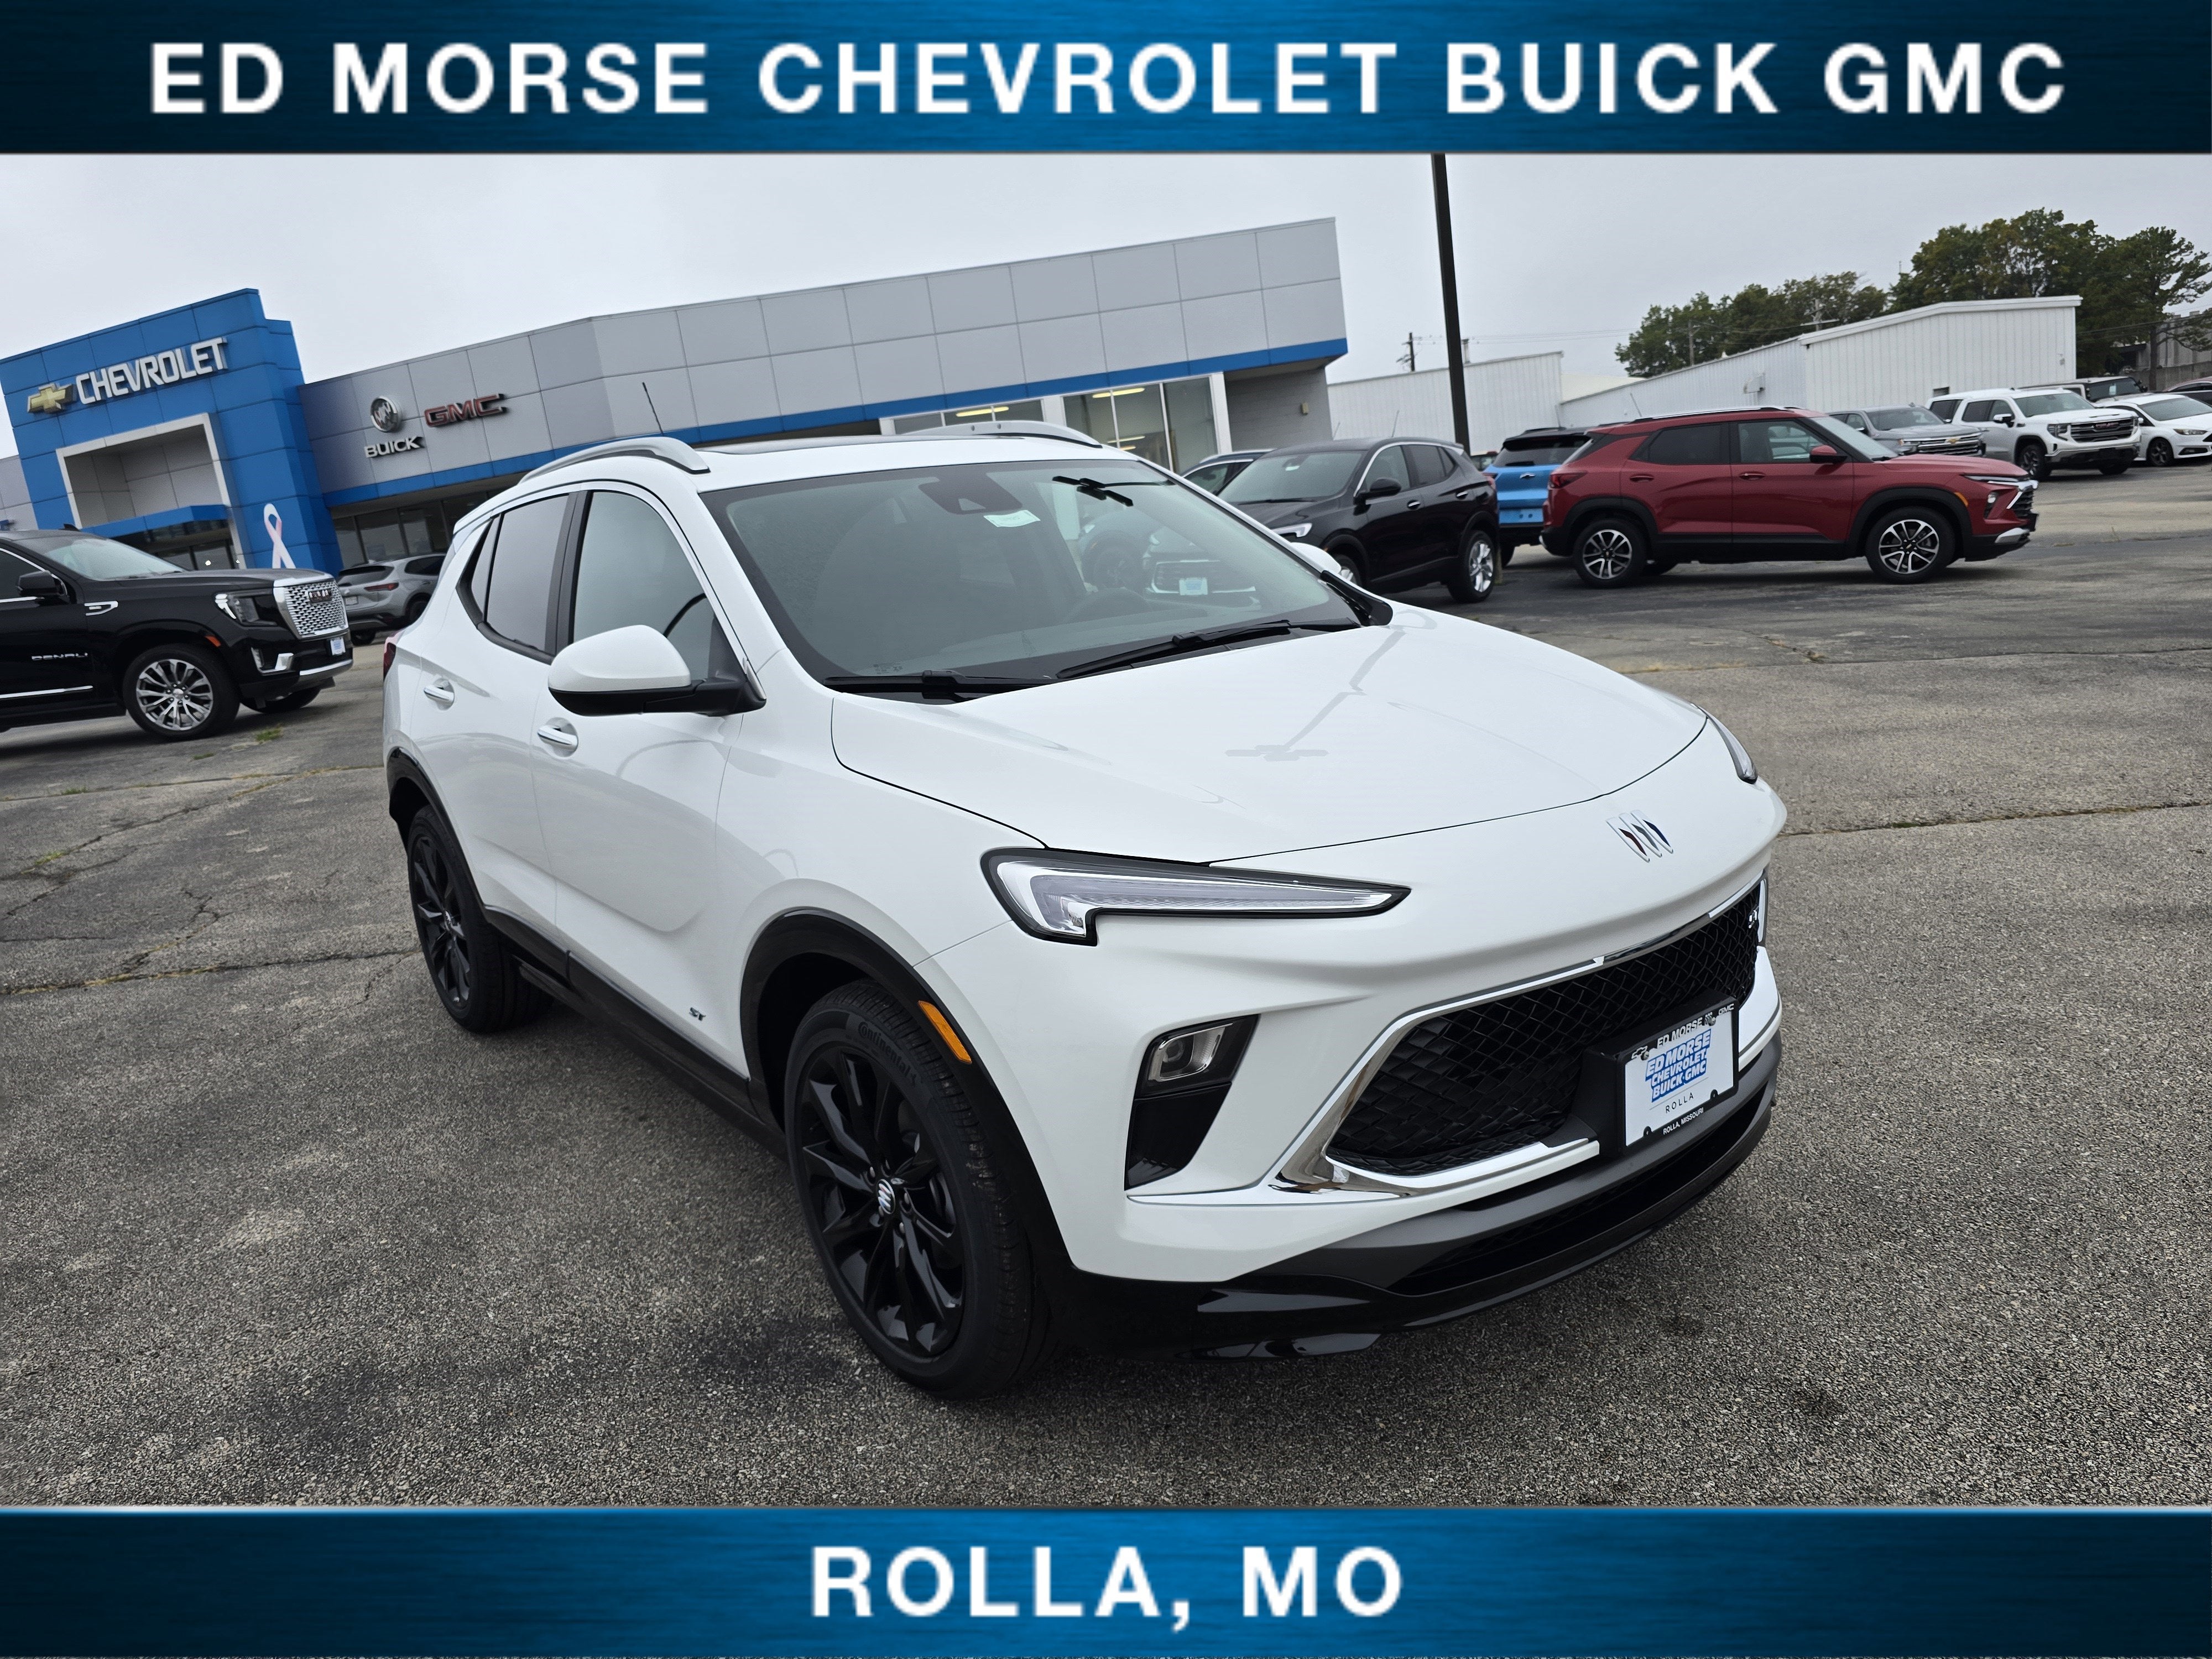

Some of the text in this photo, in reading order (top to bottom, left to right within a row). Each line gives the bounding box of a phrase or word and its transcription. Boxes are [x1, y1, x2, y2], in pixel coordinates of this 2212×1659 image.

[76, 337, 227, 404] CHEVROLET
[424, 393, 504, 427] GMC
[364, 436, 422, 458] BUICK
[1719, 1004, 1734, 1015] GMC
[858, 1021, 911, 1077] Continental
[1657, 1018, 1703, 1048] ED MORSE
[1646, 1029, 1711, 1079] ED MORSE
[1651, 1048, 1707, 1087] CHEVROLET
[1665, 1092, 1694, 1114] ROLLA
[1663, 1107, 1704, 1135] ROLLA, MISSOURI
